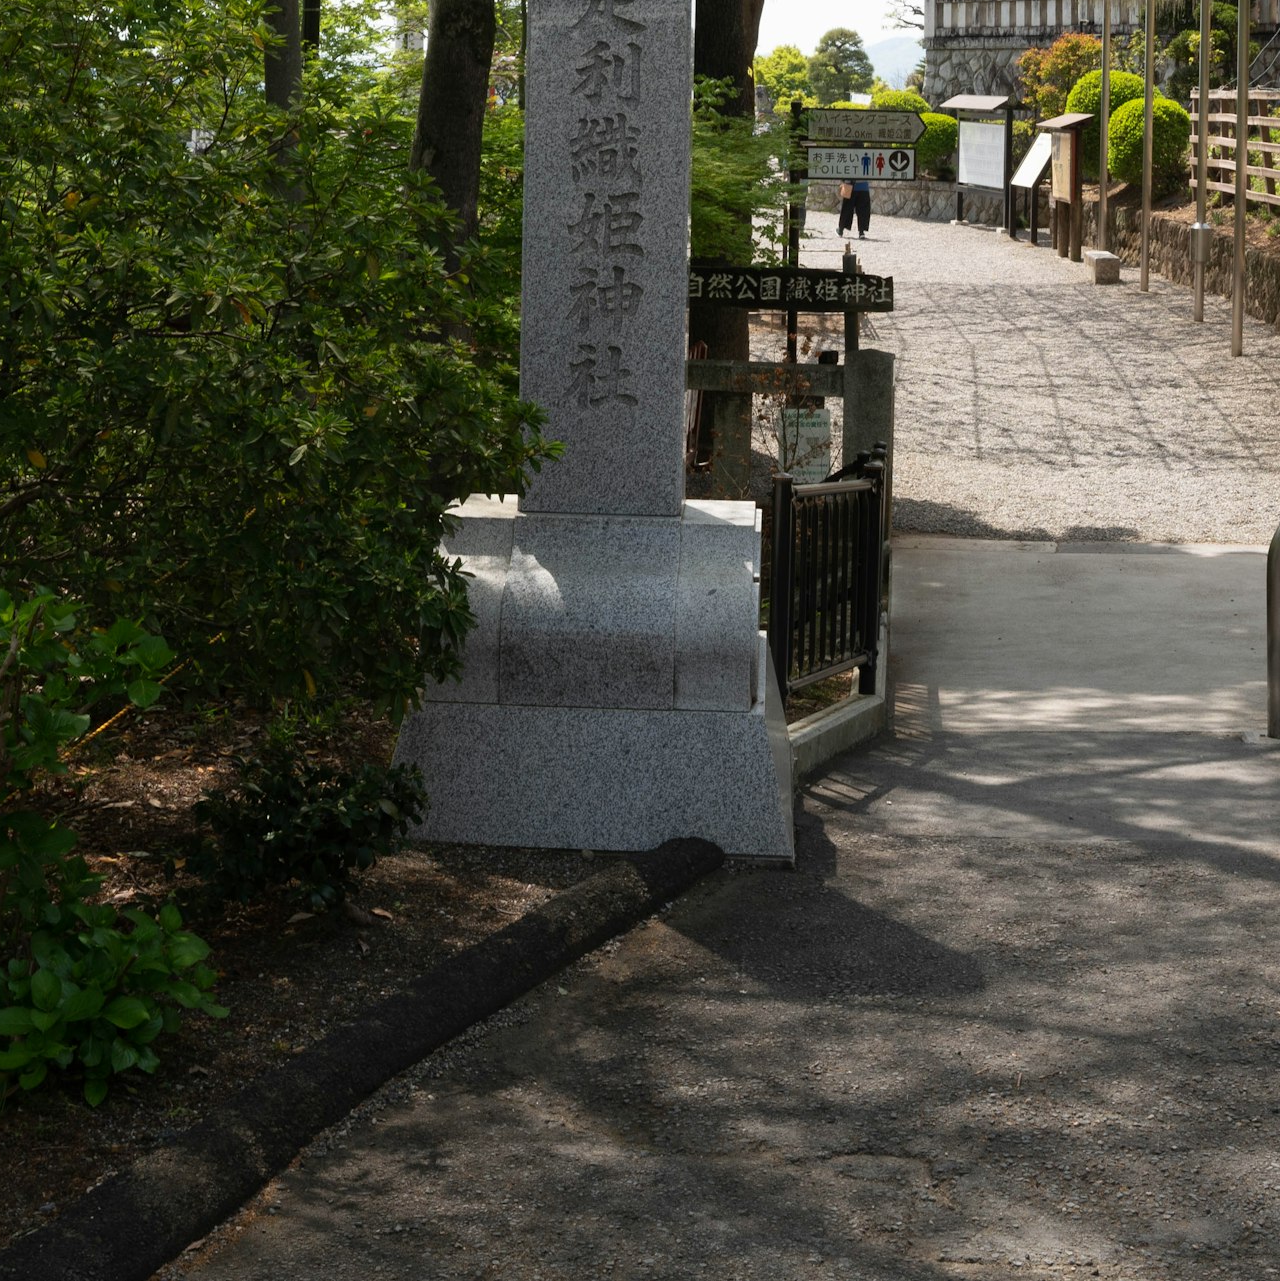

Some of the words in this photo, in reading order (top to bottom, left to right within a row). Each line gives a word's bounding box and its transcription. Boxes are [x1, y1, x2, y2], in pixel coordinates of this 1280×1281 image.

[818, 113, 912, 126] ハイキングコース
[812, 152, 860, 163] お手洗い
[813, 165, 859, 175] TOILET
